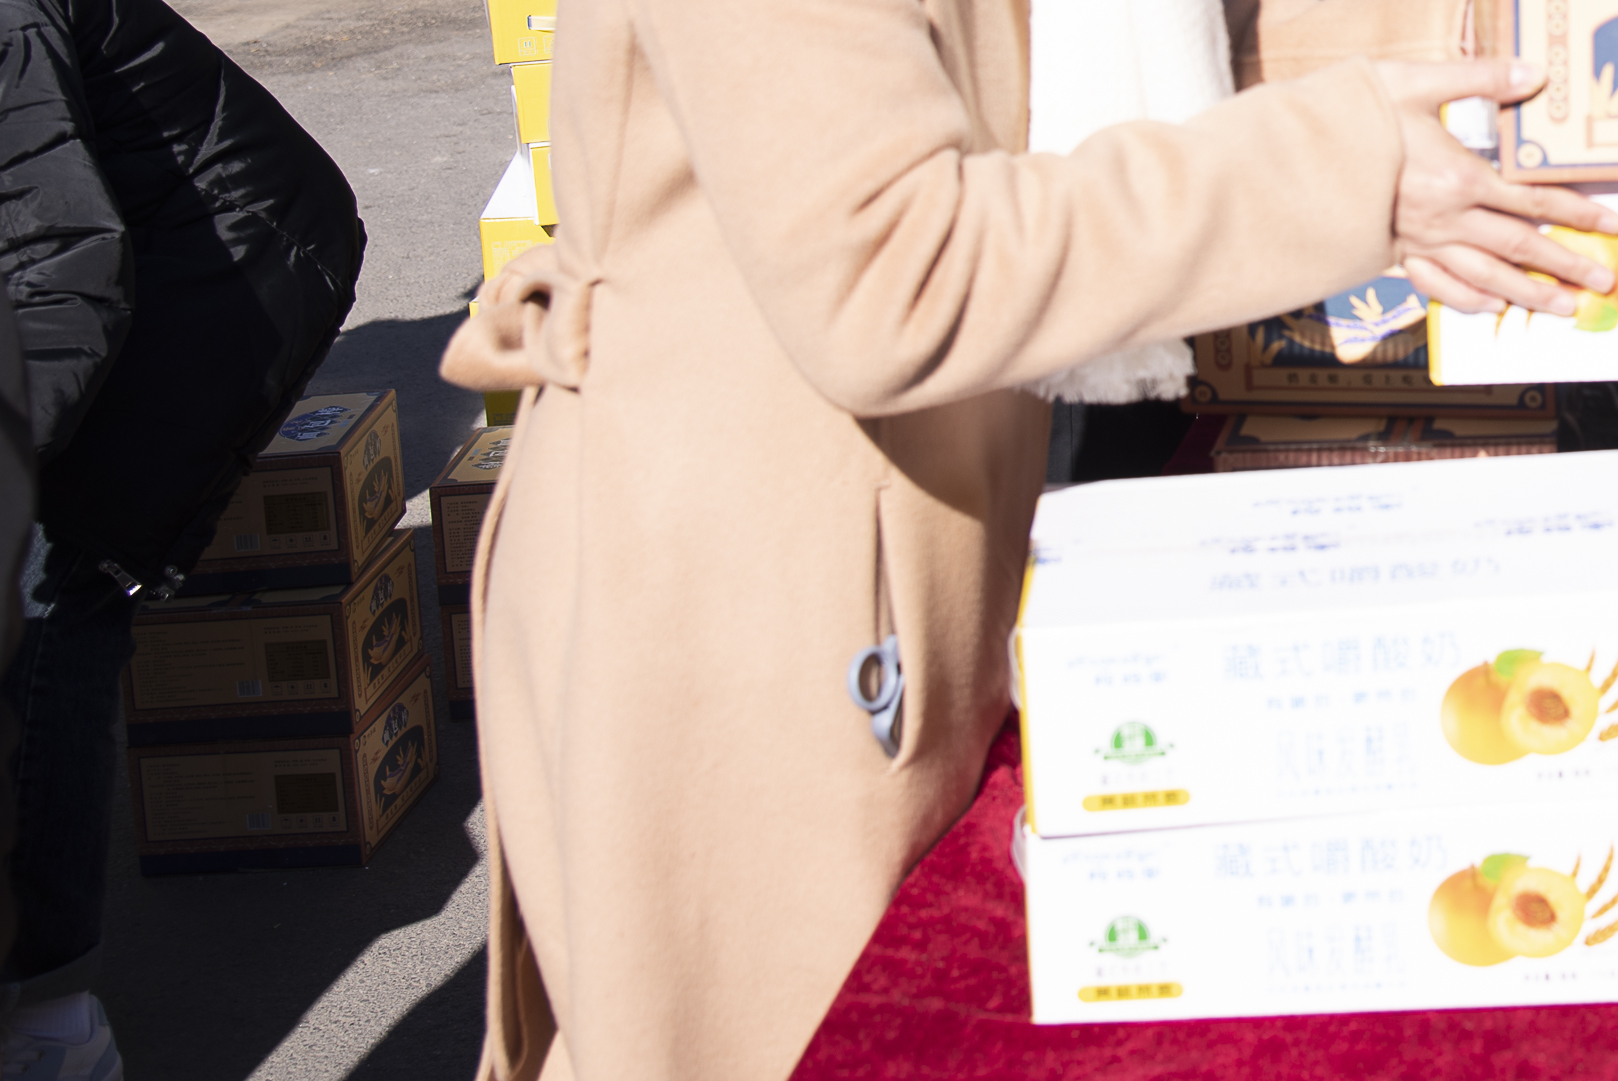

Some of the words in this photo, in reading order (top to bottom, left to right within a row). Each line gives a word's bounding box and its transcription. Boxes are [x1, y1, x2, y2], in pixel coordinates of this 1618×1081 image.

[1275, 720, 1419, 782] 风味发酵乳
[1266, 922, 1408, 978] 风味发酵乳
